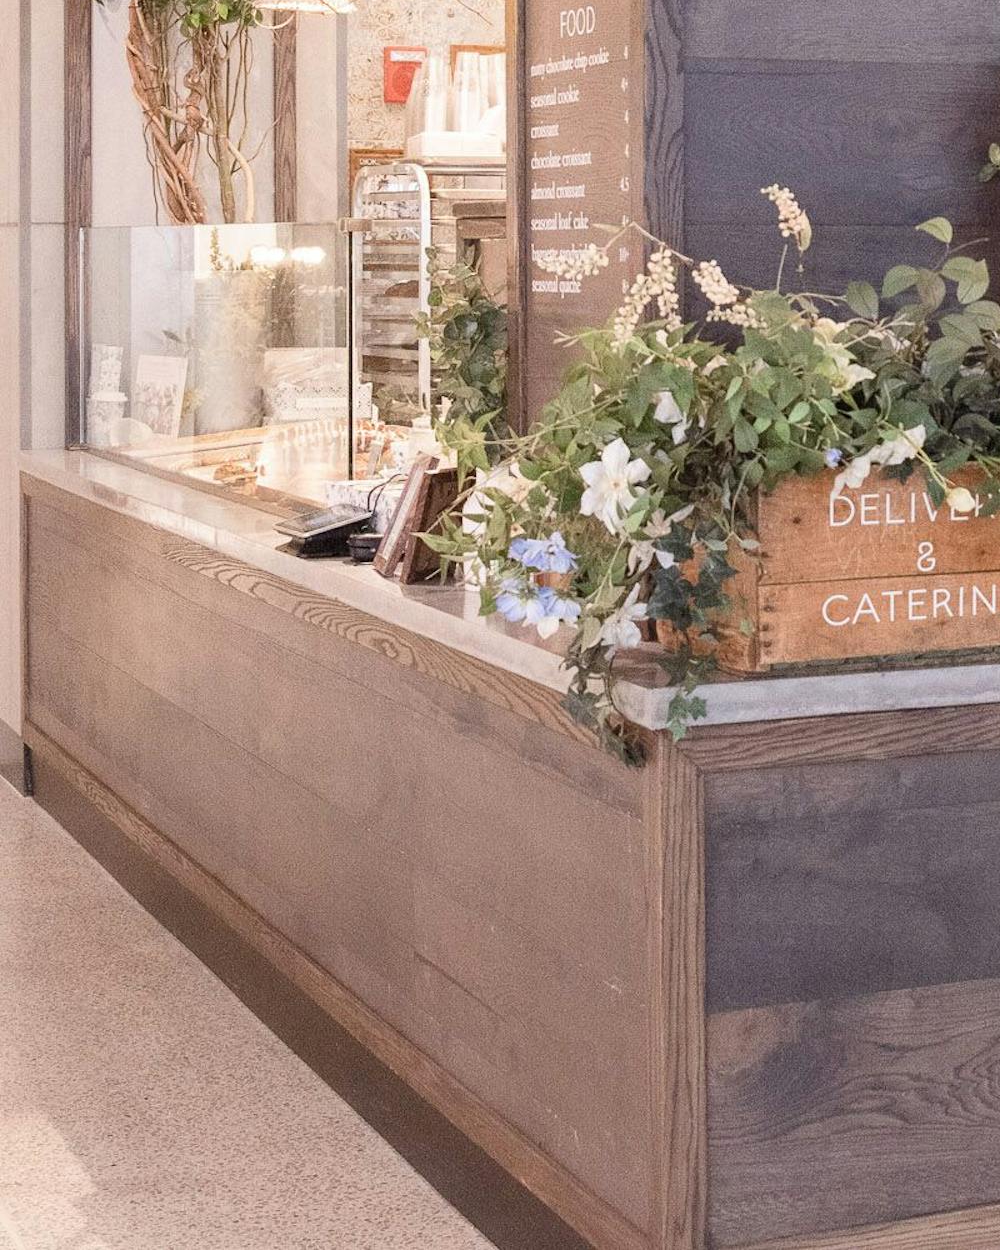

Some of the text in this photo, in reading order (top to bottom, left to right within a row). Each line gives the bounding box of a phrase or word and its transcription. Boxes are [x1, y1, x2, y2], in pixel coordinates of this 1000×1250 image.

[560, 6, 596, 38] FOOD
[546, 56, 574, 74] chocolate
[574, 52, 588, 73] chip
[588, 46, 610, 66] cookie
[530, 84, 580, 108] seasonal cookie
[530, 120, 560, 138] croissant
[531, 148, 592, 170] chocolate croissant
[531, 180, 586, 200] almond croissant
[531, 212, 590, 230] seasonal loaf cake
[532, 276, 582, 298] seasonal quiche
[916, 541, 936, 572] &
